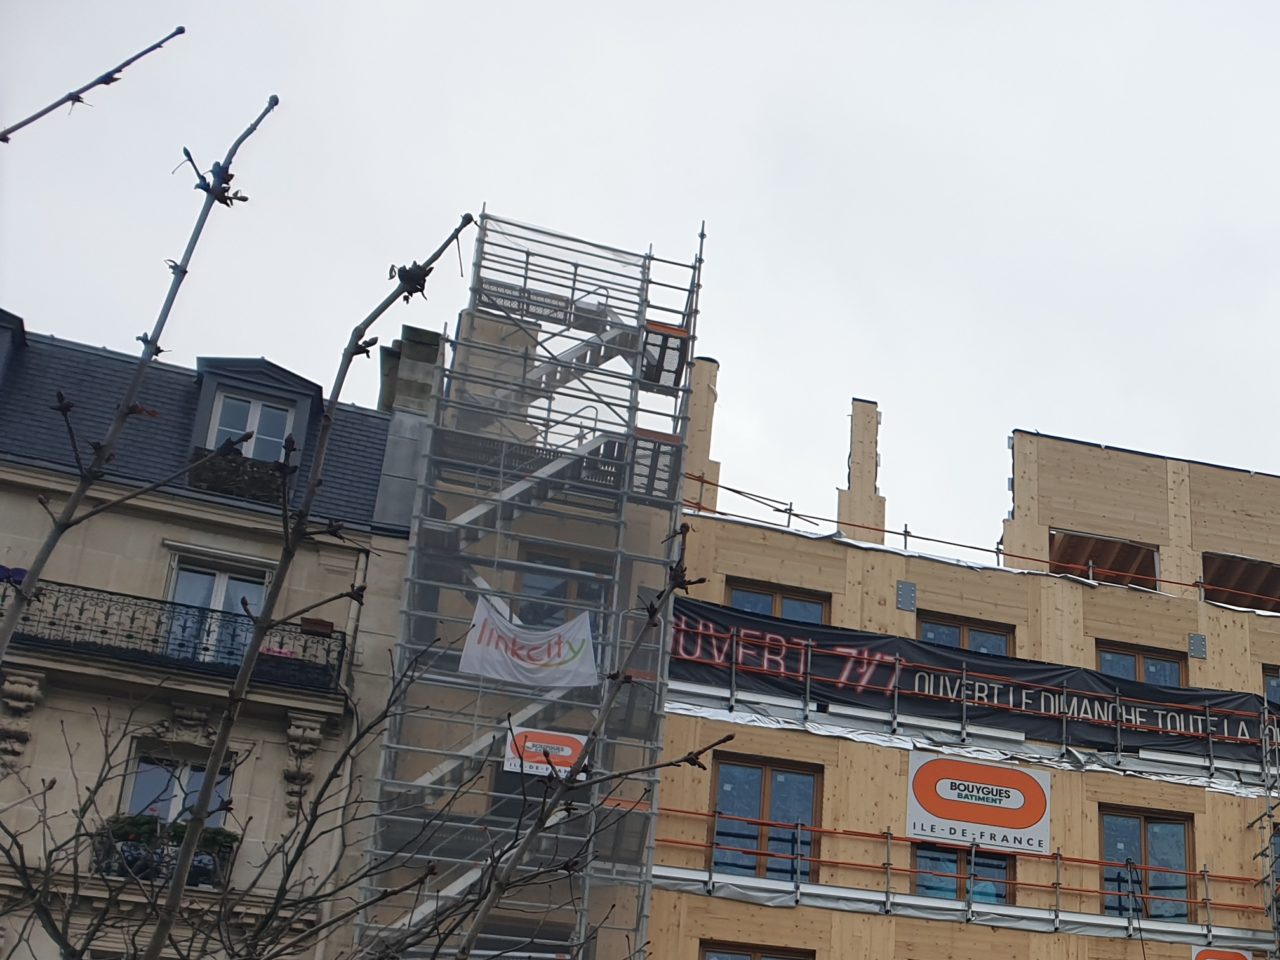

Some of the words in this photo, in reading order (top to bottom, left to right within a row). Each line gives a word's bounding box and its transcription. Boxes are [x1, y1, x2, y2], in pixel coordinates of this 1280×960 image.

[476, 617, 587, 668] linkcity
[672, 615, 815, 680] UVERT
[914, 671, 1004, 707] OUVERT
[1008, 685, 1036, 714] LE
[1040, 691, 1149, 731] DIMANCHE
[1152, 709, 1219, 742] TOUTE
[1223, 718, 1256, 744] LA
[949, 781, 1011, 799] BOUYGUES
[956, 792, 1004, 805] BATIMENT
[912, 821, 1045, 848] ILE-DE-FRANCE
